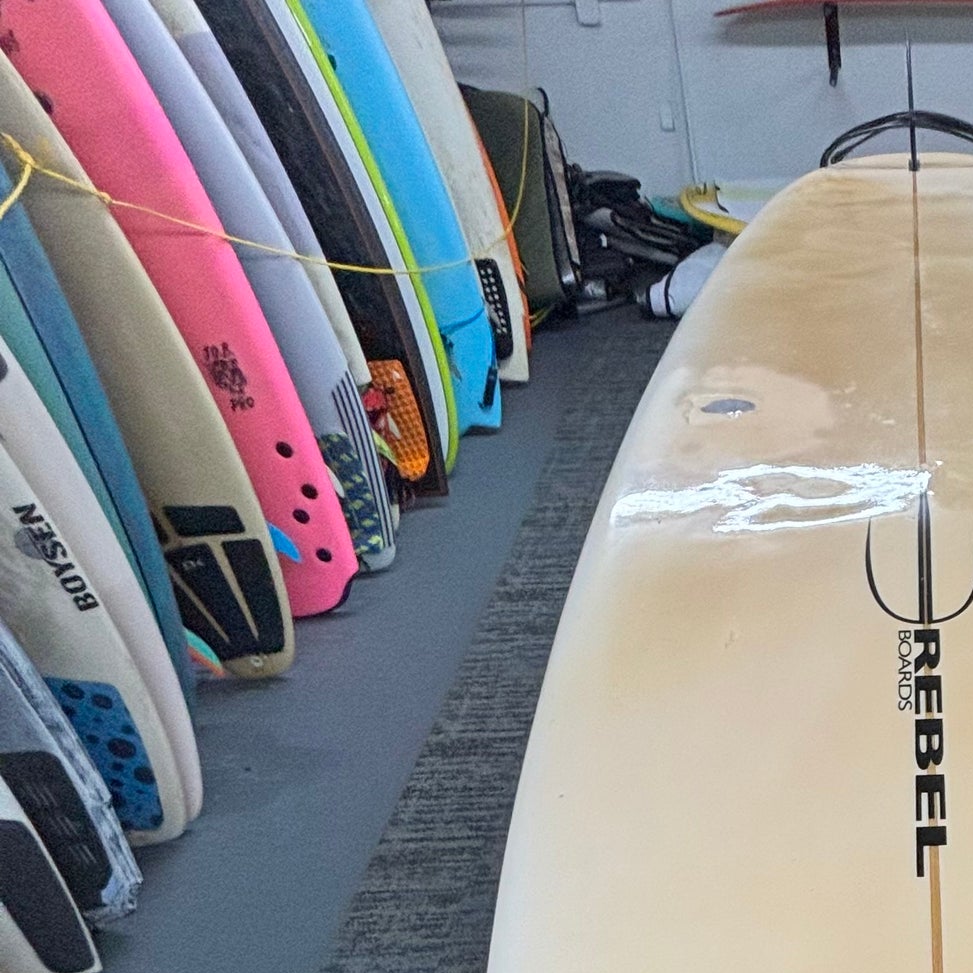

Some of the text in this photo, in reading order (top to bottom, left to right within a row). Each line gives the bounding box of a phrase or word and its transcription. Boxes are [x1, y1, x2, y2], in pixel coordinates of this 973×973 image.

[12, 503, 99, 611] BOYSEN
[898, 630, 912, 711] BOARDS
[914, 629, 947, 877] REBEL
